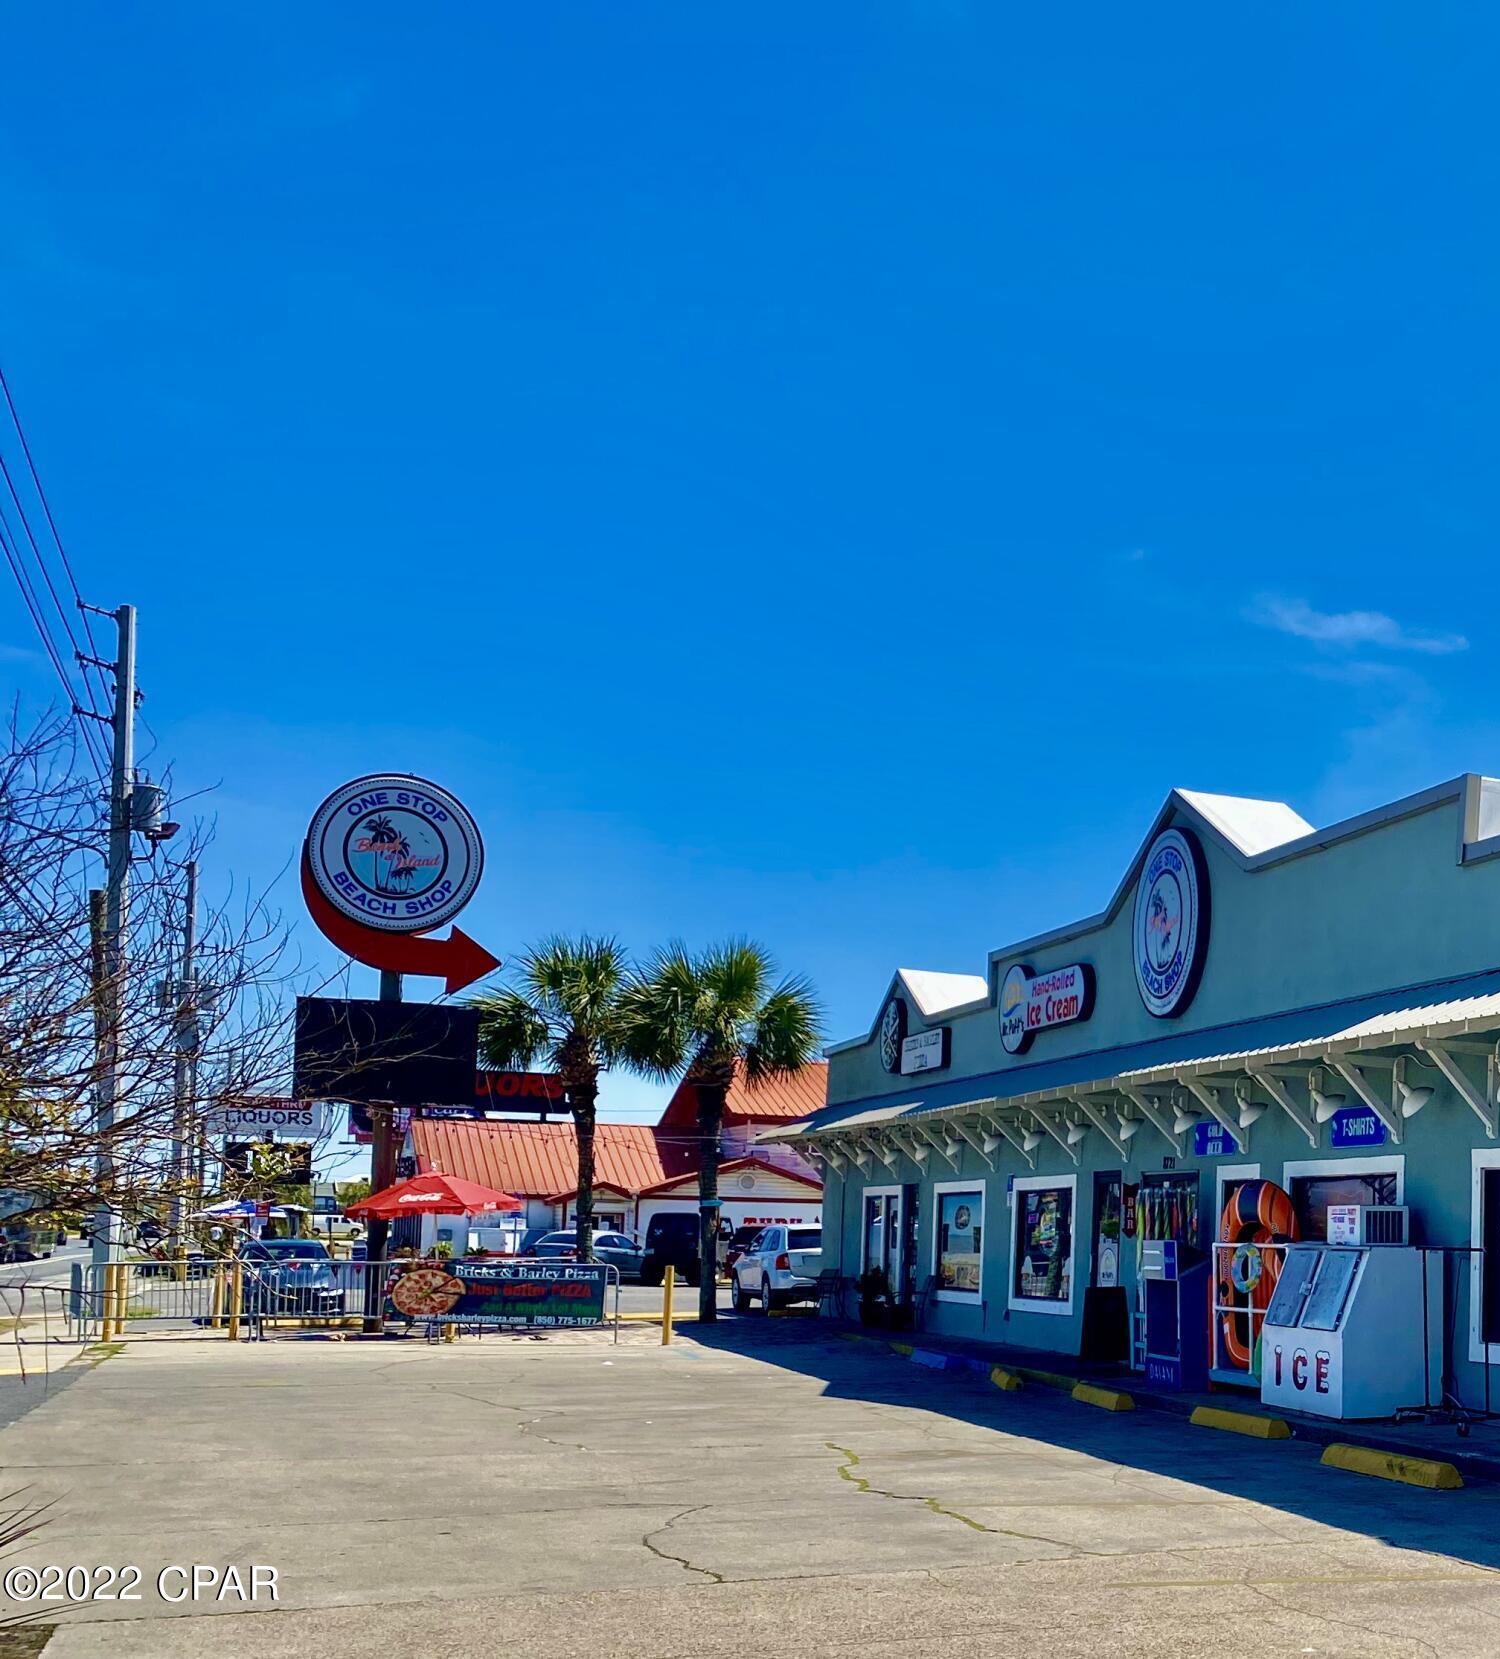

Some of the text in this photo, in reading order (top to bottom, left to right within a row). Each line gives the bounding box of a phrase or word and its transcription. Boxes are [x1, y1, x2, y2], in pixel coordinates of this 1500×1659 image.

[347, 792, 448, 824] ONE STOP
[1164, 851, 1182, 873] STOP
[333, 871, 452, 915] BEACH SHOP
[1164, 950, 1183, 991] SHOP
[1027, 995, 1078, 1027] Ice Cream
[475, 1072, 564, 1099] UORS
[1342, 1116, 1375, 1137] T-SHIRTS
[455, 1265, 496, 1279] Bricks
[518, 1268, 561, 1283] Barley
[1274, 1344, 1330, 1393] ICE
